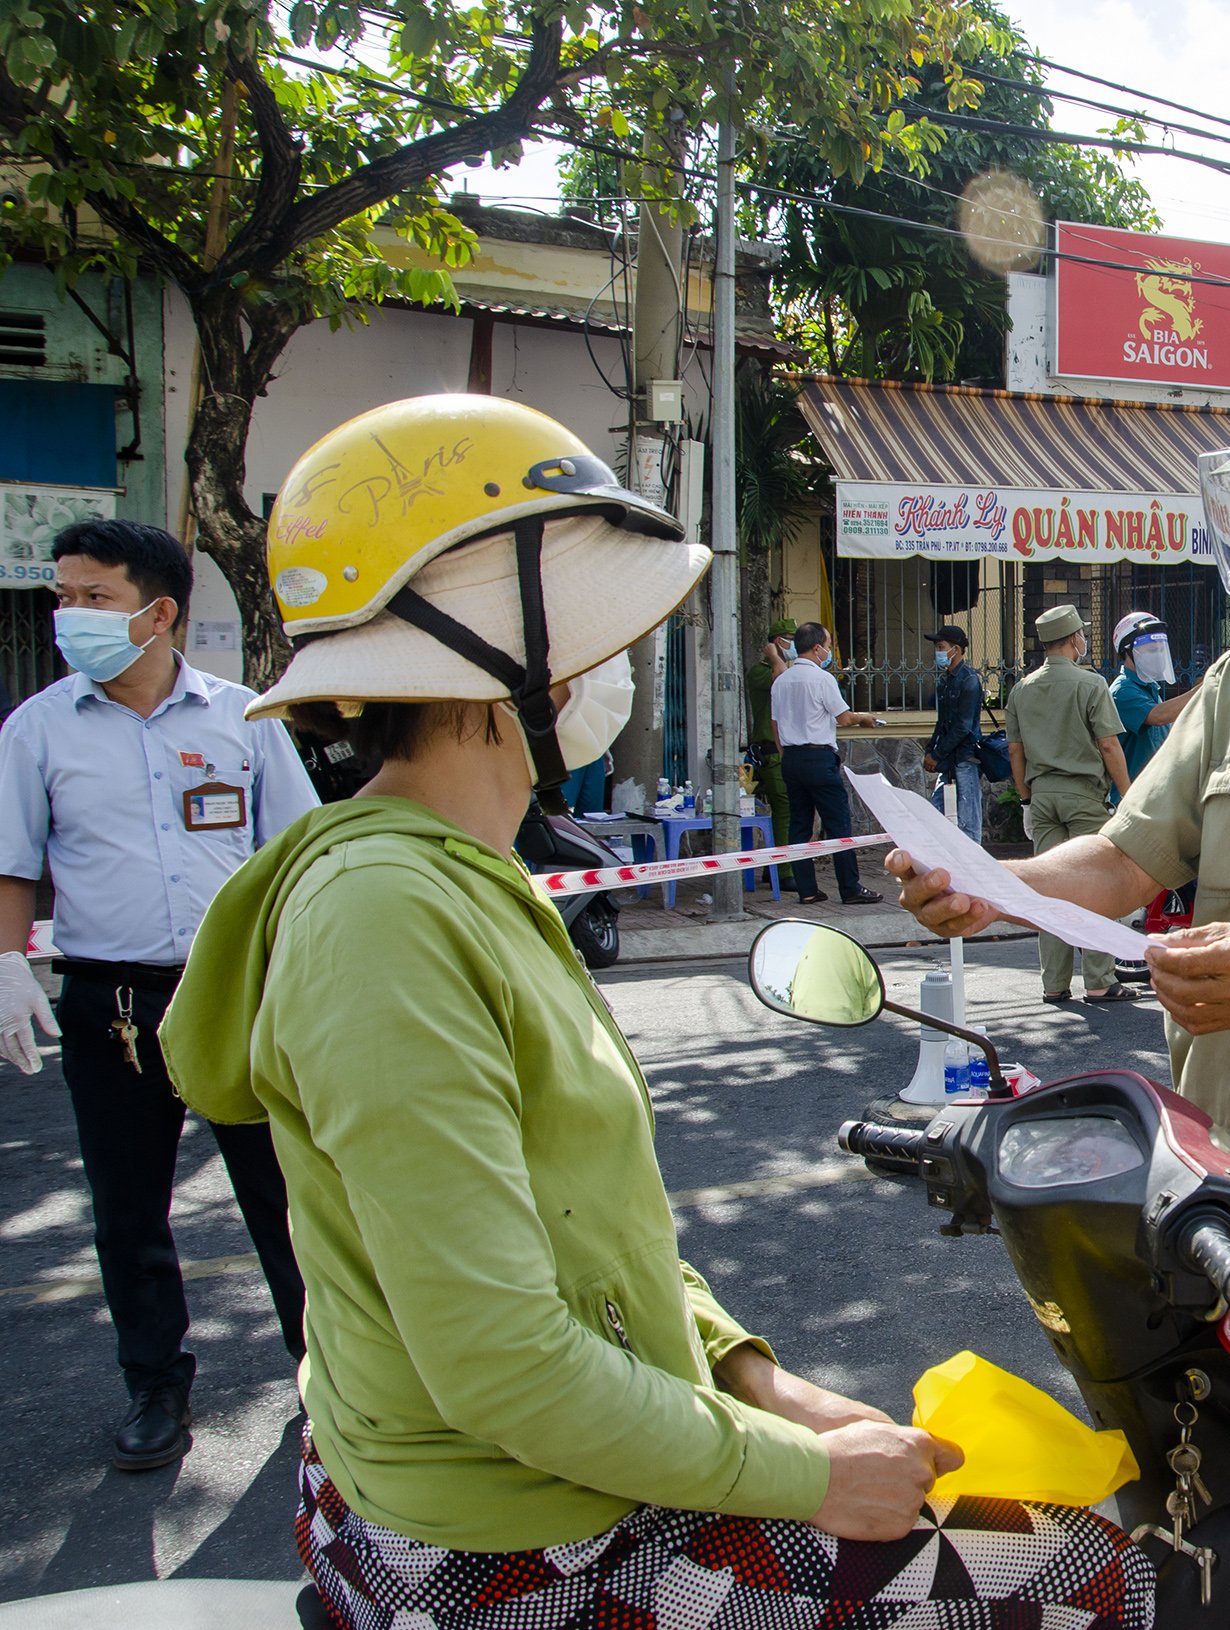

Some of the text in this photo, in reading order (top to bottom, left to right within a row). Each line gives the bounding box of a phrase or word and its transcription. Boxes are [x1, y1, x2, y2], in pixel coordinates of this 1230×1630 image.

[1153, 329, 1180, 345] BIA
[1123, 341, 1209, 369] SAIGON
[276, 514, 329, 545] Eiffel
[894, 492, 971, 538] Khánh
[973, 490, 1008, 541] Ly
[1011, 496, 1099, 558] QUÁN
[1104, 499, 1189, 560] NHẬU
[905, 540, 915, 551] 335
[945, 541, 960, 552] TP.VT
